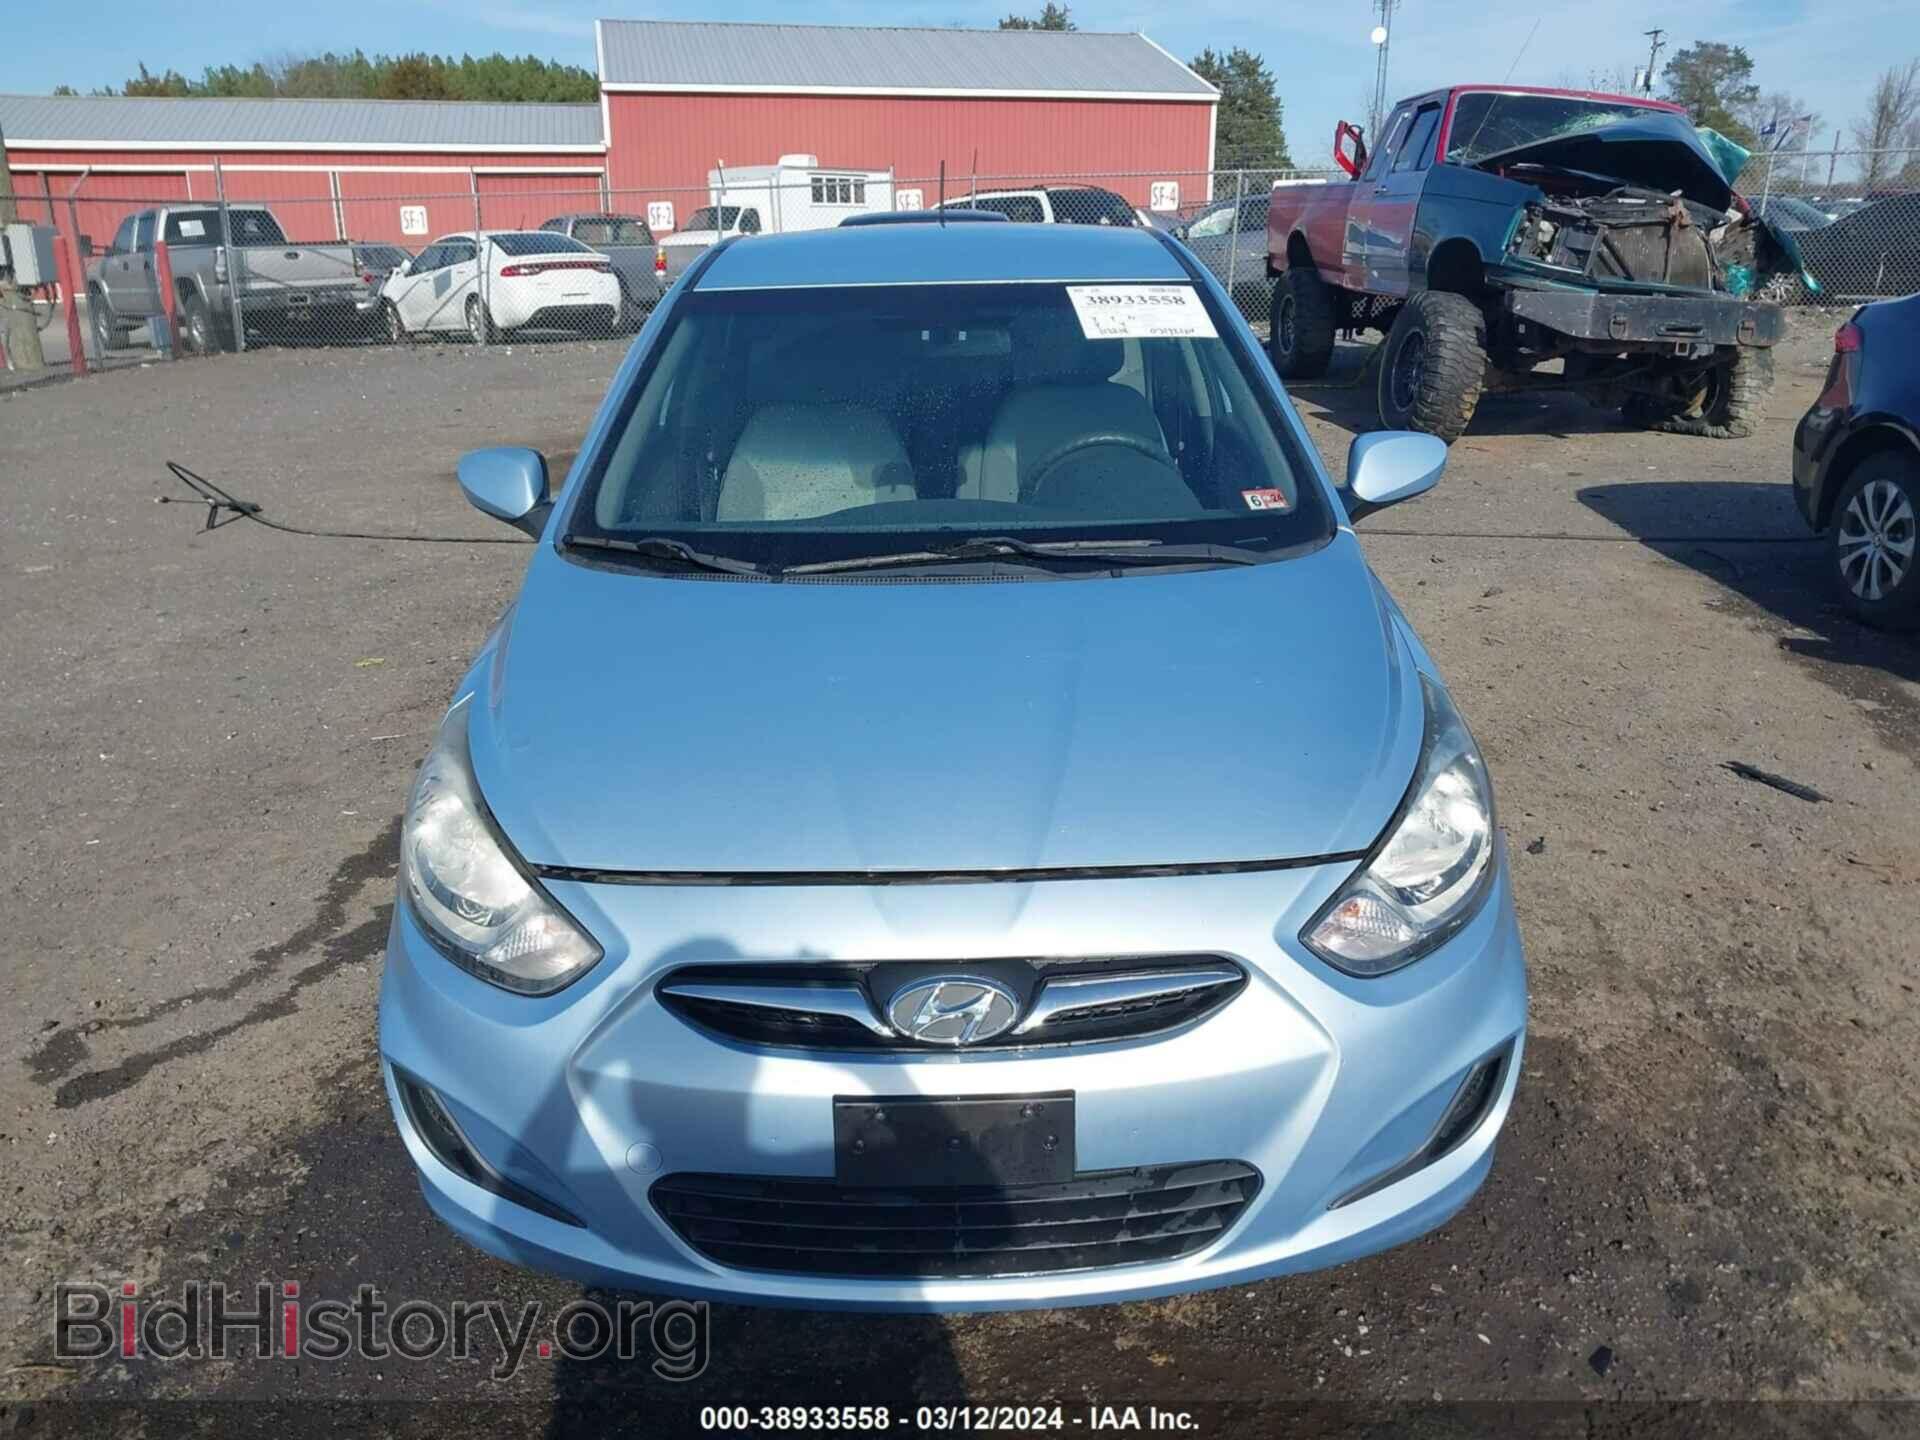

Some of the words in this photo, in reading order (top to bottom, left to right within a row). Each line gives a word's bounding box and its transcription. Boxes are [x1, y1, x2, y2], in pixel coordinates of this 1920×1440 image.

[1152, 185, 1176, 206] SF-4
[403, 210, 425, 230] SF-1
[650, 205, 672, 226] SF-2
[1085, 295, 1186, 305] 38933558
[1250, 495, 1262, 507] 6
